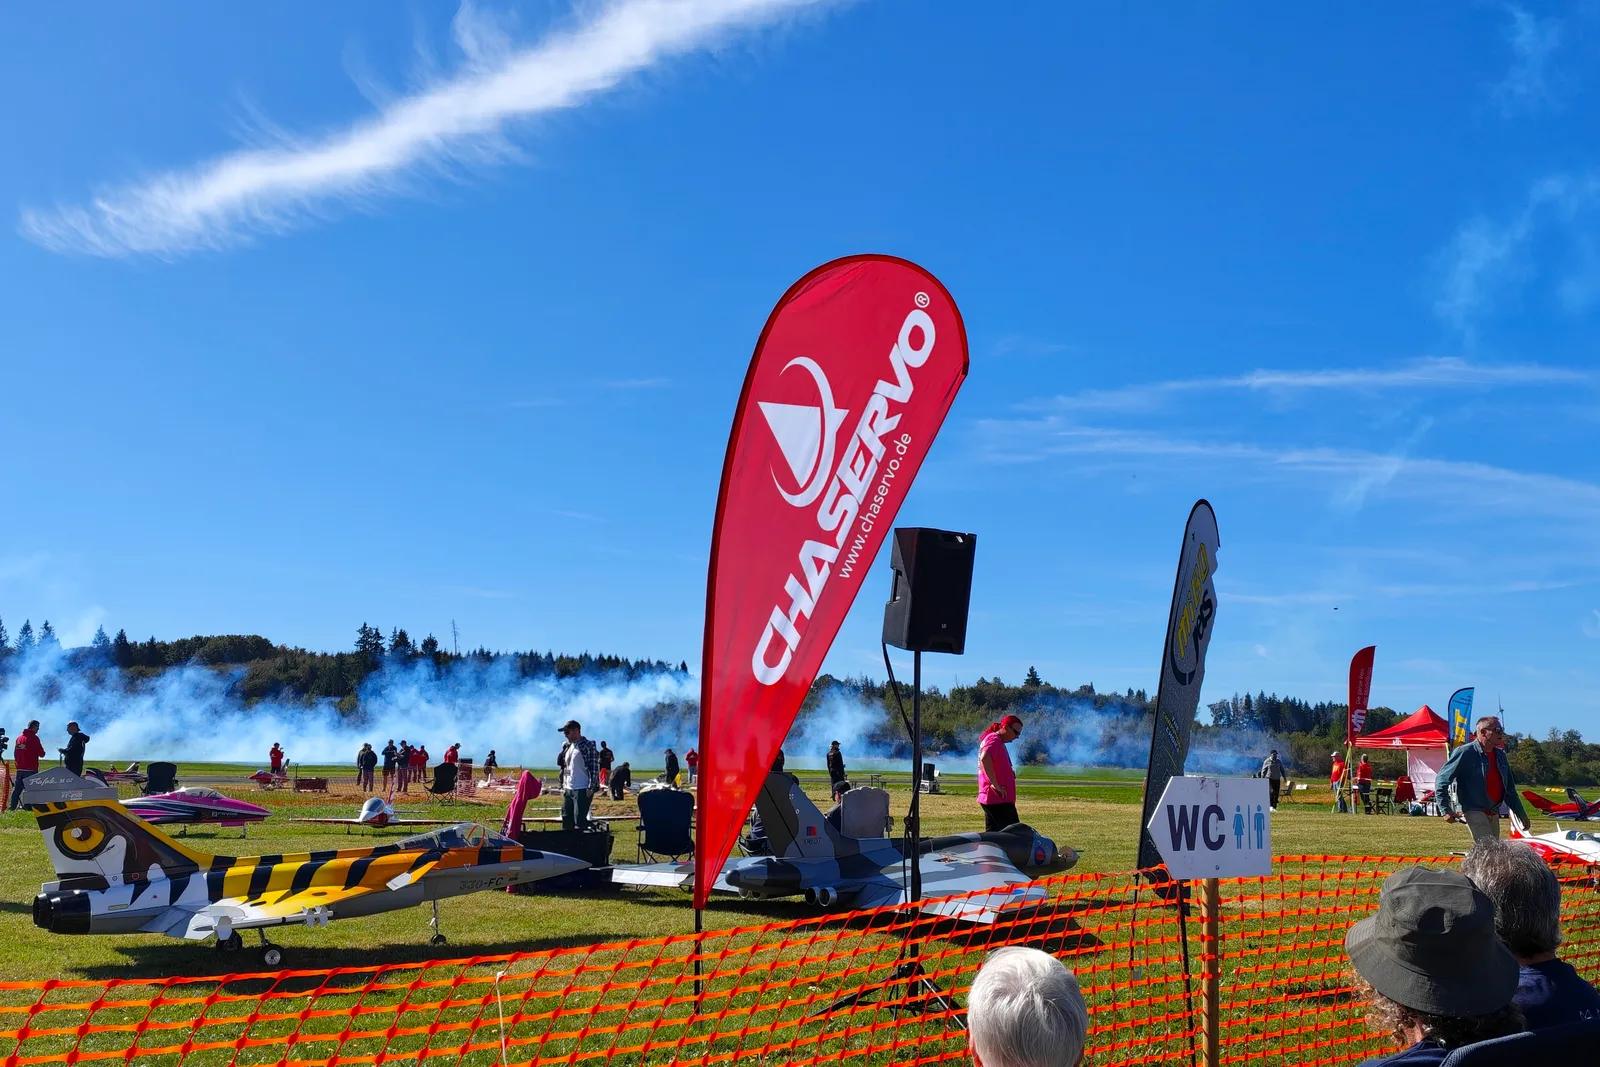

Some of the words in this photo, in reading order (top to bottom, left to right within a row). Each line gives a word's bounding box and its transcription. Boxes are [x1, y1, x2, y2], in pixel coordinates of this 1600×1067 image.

[839, 433, 912, 579] www.chaservo.de
[1167, 804, 1225, 851] WC
[459, 877, 504, 891] 330-FC
